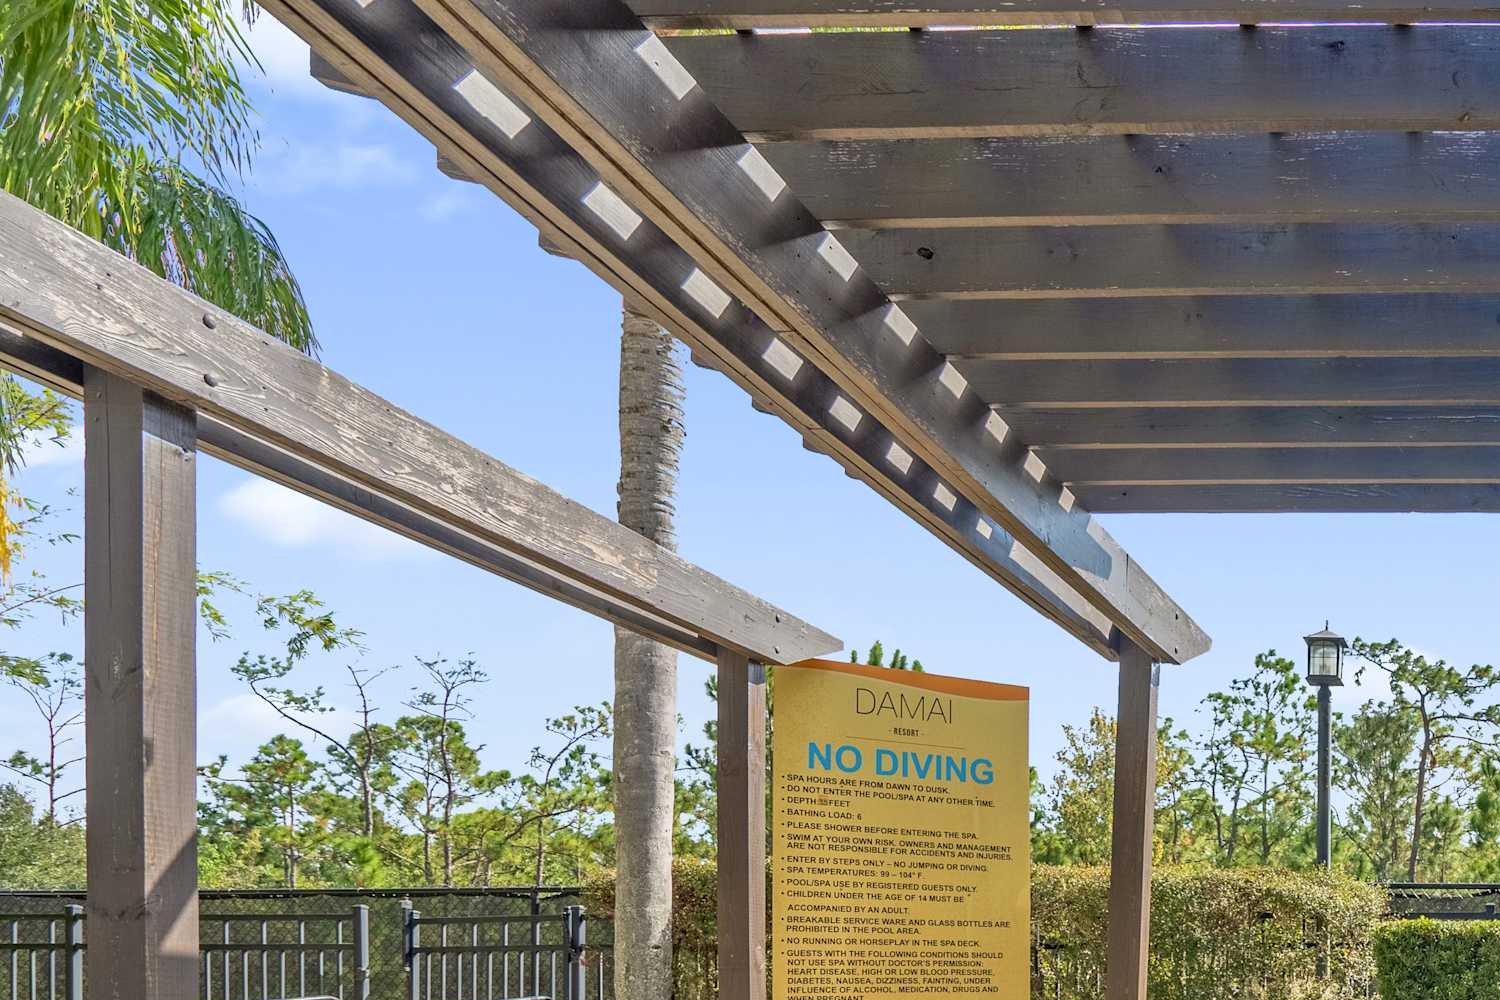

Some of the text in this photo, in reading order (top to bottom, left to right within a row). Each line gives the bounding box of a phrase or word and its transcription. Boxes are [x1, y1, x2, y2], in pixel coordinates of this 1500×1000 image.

[856, 688, 952, 724] DAMAI
[894, 728, 920, 736] RESORT
[808, 742, 994, 785] NO DIVING
[786, 774, 804, 783] SPA
[806, 775, 837, 785] HOURS
[840, 778, 857, 787] ARE
[859, 780, 883, 789] FROM
[886, 782, 910, 792] DAWN
[913, 784, 924, 793] TO
[787, 784, 800, 793] DO
[802, 785, 820, 794] NOT
[823, 787, 852, 797] ENTER
[854, 790, 870, 798] THE
[872, 791, 914, 802] POOL/SPA
[916, 795, 927, 803] AT
[928, 795, 944, 804] ANY
[946, 797, 974, 807] OTHER
[787, 796, 816, 806] DEPTH
[829, 799, 850, 808] FEET
[787, 808, 826, 818] BATHING
[857, 813, 862, 821] 6
[787, 821, 822, 830] PLEASE
[824, 823, 862, 833] SHOWER
[864, 826, 898, 835] BEFORE
[900, 828, 942, 838] ENTERING
[944, 831, 959, 839] THE
[787, 833, 811, 842] SWIM
[812, 834, 824, 843] AT
[826, 835, 850, 844] YOUR
[852, 837, 872, 845] OWN
[899, 839, 936, 849] OWNERS
[937, 842, 954, 850] AND
[956, 843, 1011, 853] MANAGEMENT
[787, 841, 804, 850] ARE
[806, 842, 826, 851] NOT
[828, 844, 888, 855] RESPONSIBLE
[890, 847, 907, 856] FOR
[909, 848, 956, 859] ACCIDENTS
[958, 851, 974, 860] AND
[786, 878, 830, 887] POOL/SPA
[832, 880, 850, 888] USE
[853, 881, 864, 889] BY
[866, 881, 919, 891] REGISTERED
[921, 883, 954, 892] GUESTS
[786, 915, 1011, 928] BREAKABLE SERVICE WARE AND GLASS BOTTLES ARE
[786, 924, 840, 933] PROHIBITED
[841, 926, 850, 934] IN
[853, 926, 869, 934] THE
[871, 926, 895, 935] POOL
[786, 949, 1003, 959] GUESTS WITH THE FOLLOWING CONDITIONS SHOULD
[809, 959, 827, 967] USE
[828, 959, 846, 967] SPA
[847, 959, 886, 967] WITHOUT
[888, 959, 931, 967] DOCTOR'S
[787, 968, 817, 976] HEART
[862, 968, 883, 976] HIGH
[885, 968, 897, 976] OR
[899, 968, 918, 976] LOW
[920, 968, 949, 976] BLOOD
[963, 977, 991, 985] UNDER
[787, 986, 837, 994] INFLUENCE
[840, 986, 851, 994] OF
[952, 985, 980, 993] DRUGS
[981, 985, 999, 993] AND
